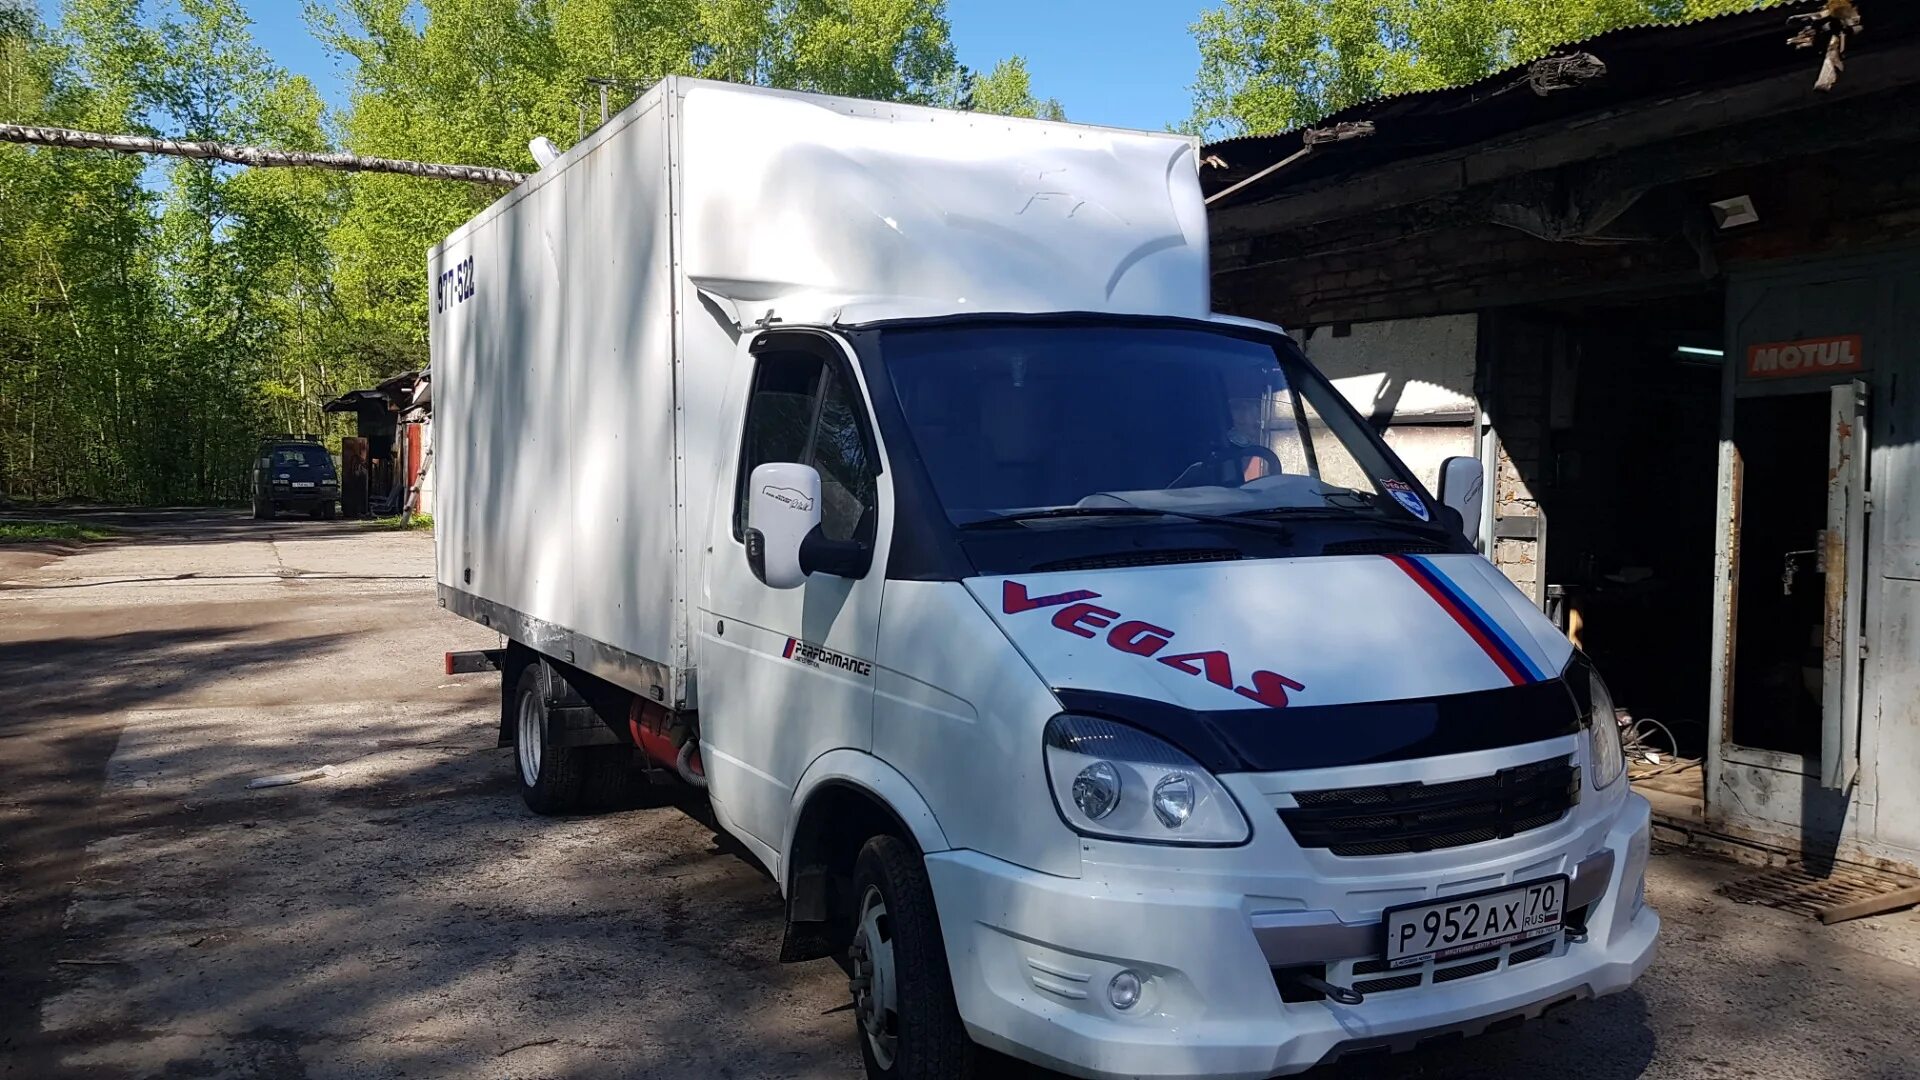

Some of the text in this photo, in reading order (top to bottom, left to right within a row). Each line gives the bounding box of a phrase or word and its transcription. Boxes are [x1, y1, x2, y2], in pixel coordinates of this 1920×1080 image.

[438, 255, 475, 314] 977-522
[1753, 341, 1855, 371] MOTUL
[796, 642, 871, 676] PERFORMANCE
[1003, 580, 1305, 708] VEGAS
[1529, 885, 1555, 916] 70
[1524, 914, 1544, 927] RUS
